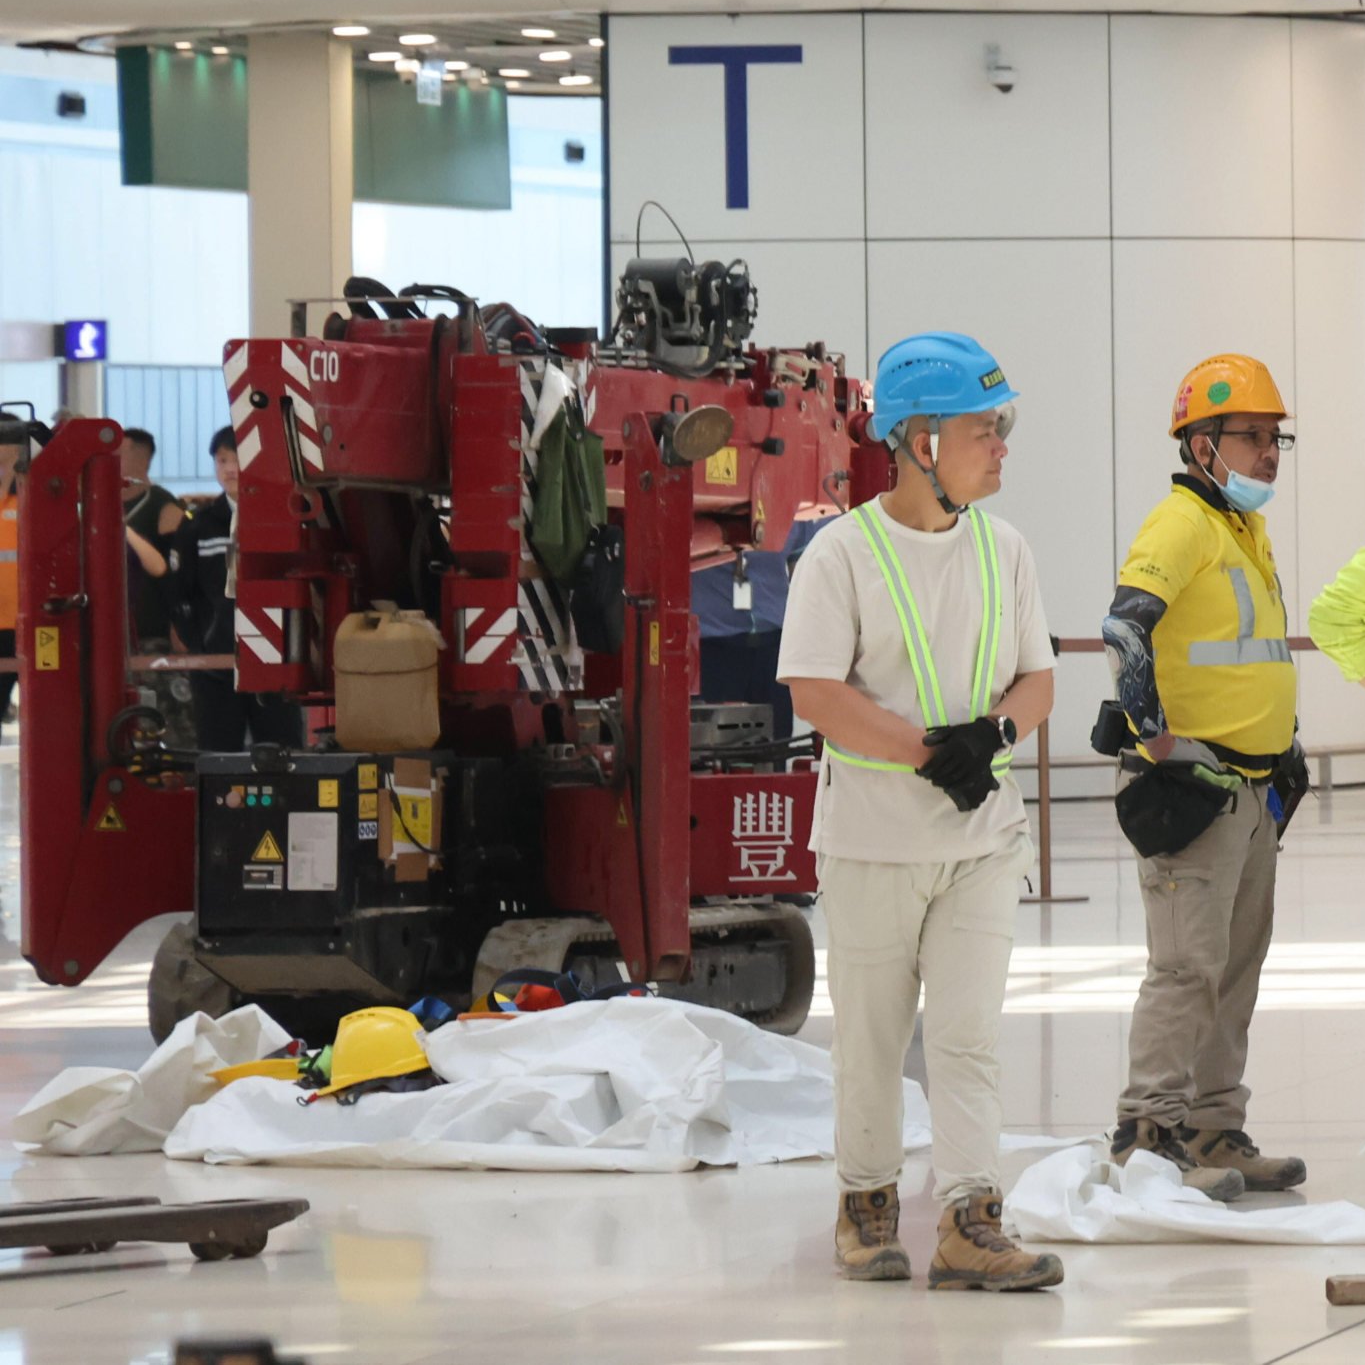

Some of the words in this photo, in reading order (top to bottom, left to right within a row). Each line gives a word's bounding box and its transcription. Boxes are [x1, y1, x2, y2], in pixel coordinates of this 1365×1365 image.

[668, 45, 803, 209] T
[310, 350, 339, 382] C10
[728, 790, 797, 882] 豐
